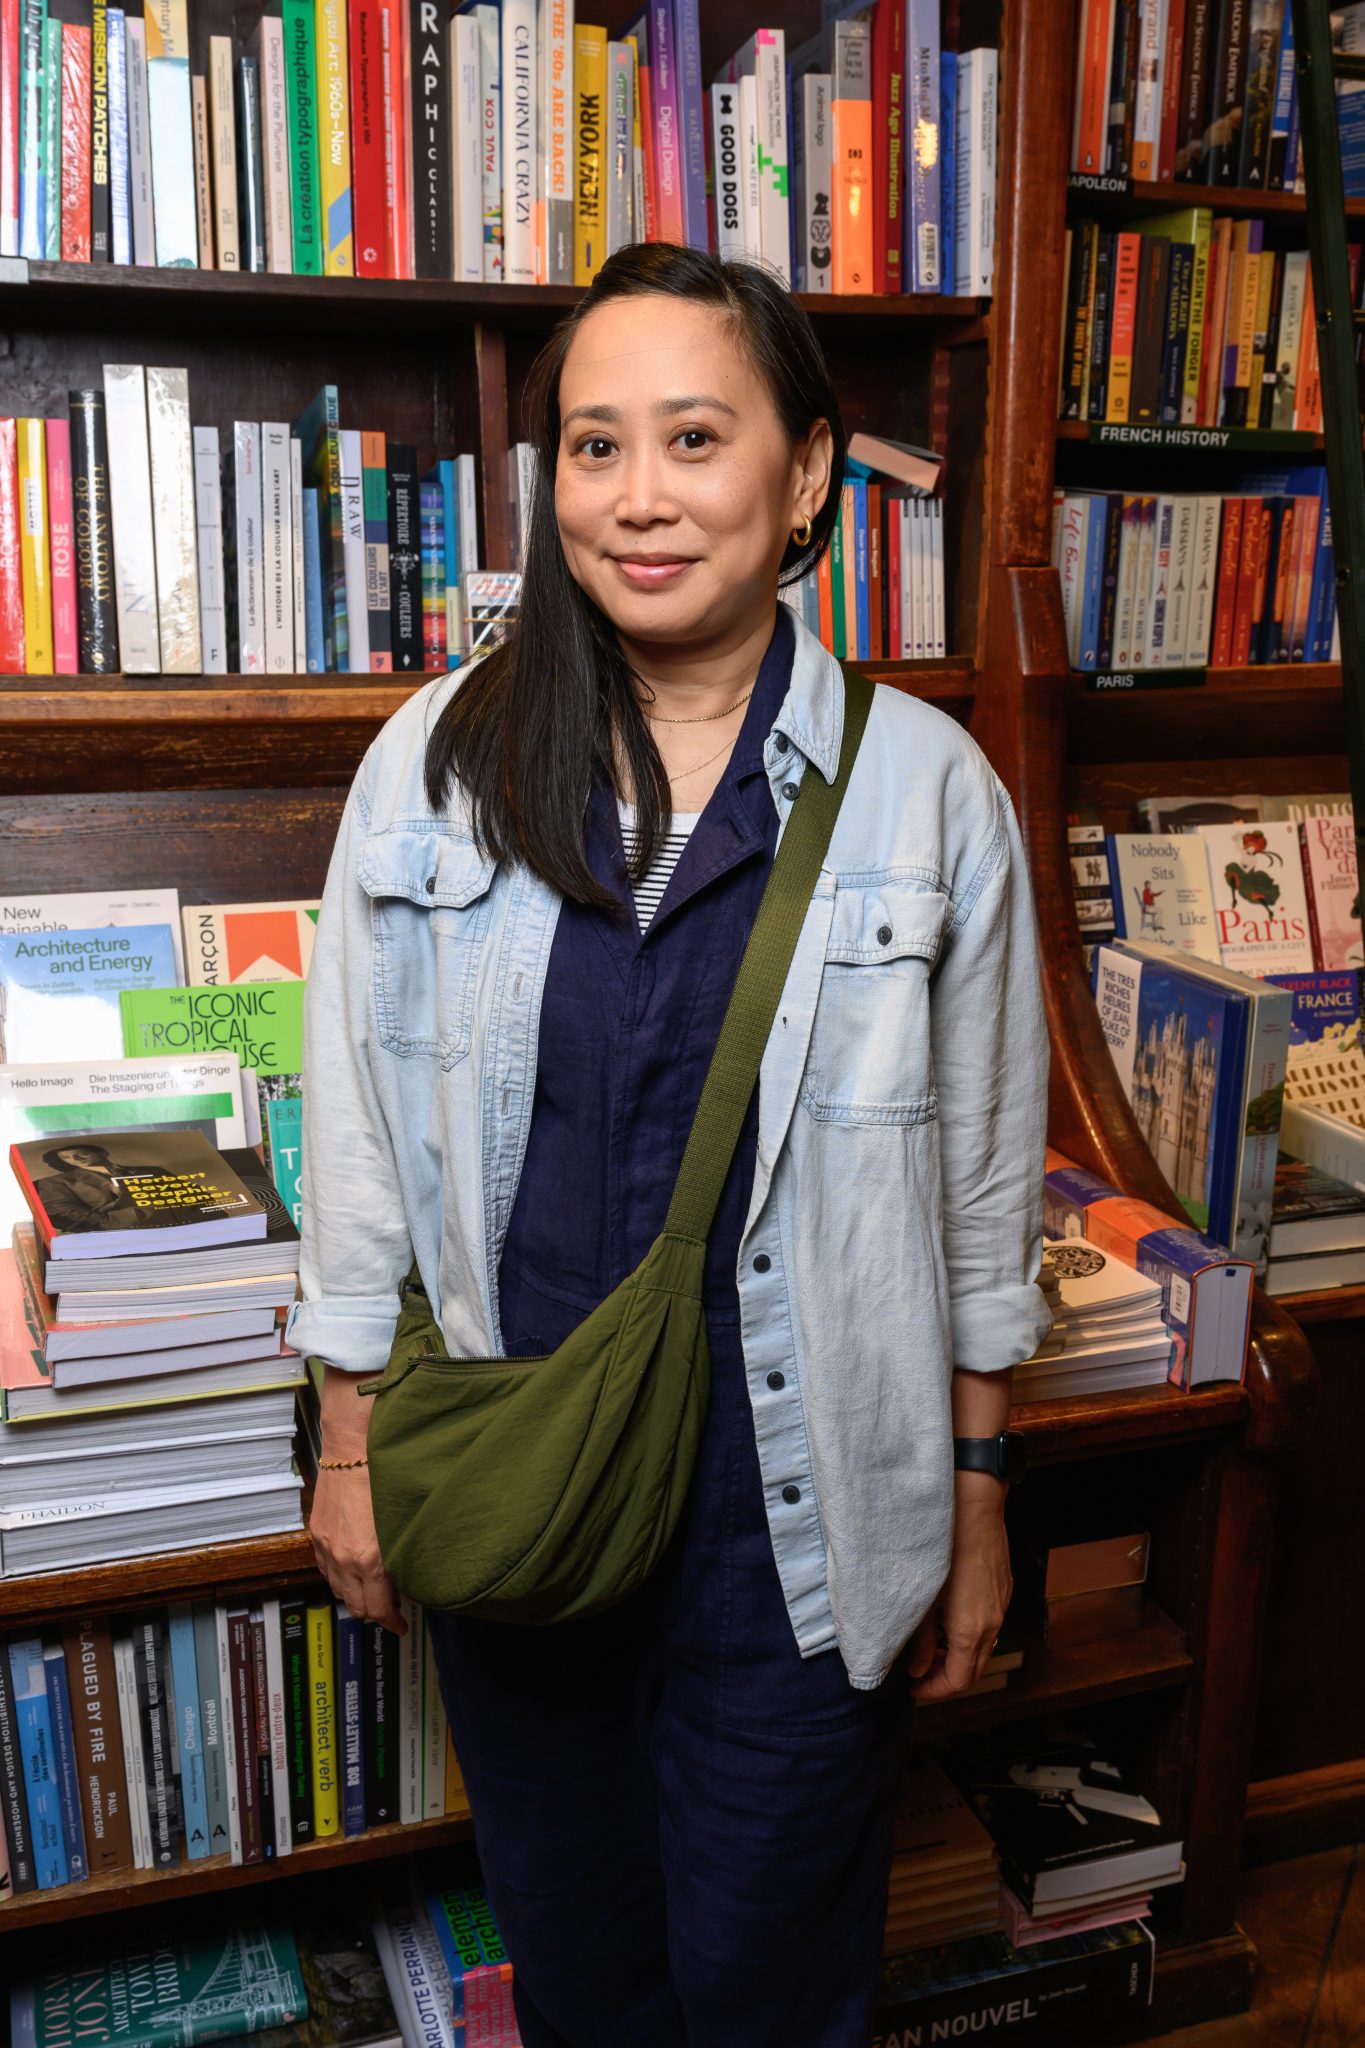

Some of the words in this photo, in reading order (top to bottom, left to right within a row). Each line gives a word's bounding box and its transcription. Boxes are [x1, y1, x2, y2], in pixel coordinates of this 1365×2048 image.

[552, 2, 564, 39] THE
[657, 8, 666, 45] Stephen
[93, 9, 107, 91] MISSION
[270, 37, 281, 80] Designs
[1191, 26, 1205, 72] SHADOW
[292, 18, 312, 146] typographique
[360, 58, 370, 113] Typography
[514, 25, 530, 151] CALIFORNIA
[889, 73, 901, 103] Jazz
[1225, 47, 1240, 104] EMPEROR
[272, 84, 281, 99] for
[552, 86, 564, 127] ARE
[816, 85, 826, 122] Animal
[1189, 74, 1201, 121] EMPEROR
[273, 101, 282, 119] the
[484, 98, 494, 129] COX
[579, 92, 600, 157] YORK
[889, 107, 901, 134] Age
[93, 93, 107, 185] PATCHES
[659, 106, 673, 147] Digital
[814, 123, 826, 146] logo
[273, 120, 285, 172] Pluriverse
[485, 136, 495, 172] PAUL
[720, 125, 736, 175] GOOD
[552, 133, 565, 193] BACK!
[661, 150, 674, 195] Design
[888, 138, 901, 219] Illustration
[298, 149, 313, 220] création
[515, 158, 530, 229] CRAZY
[579, 160, 600, 217] NEW
[722, 182, 738, 230] DOGS
[300, 224, 313, 244] La
[1192, 258, 1206, 325] ABSINTHE
[1285, 331, 1294, 350] SET
[1188, 331, 1201, 382] FORGER
[327, 396, 337, 428] CRUE
[1100, 426, 1162, 444] FRENCH
[1165, 428, 1230, 446] HISTORY
[329, 431, 339, 488] COULEUR
[75, 477, 89, 498] OF
[92, 464, 105, 501] THE
[341, 476, 361, 539] DRAW
[396, 488, 411, 545] RÉPERTOIRE
[429, 516, 437, 546] secrets
[1063, 507, 1083, 540] Left
[53, 522, 70, 578] ROSE
[77, 508, 93, 590] COLOUR
[95, 509, 110, 603] ANATOMY
[246, 557, 254, 567] de
[275, 559, 282, 570] LA
[1158, 551, 1170, 568] CITY
[275, 572, 282, 583] DE
[368, 546, 378, 590] COULEURS
[1063, 546, 1079, 584] Bank
[247, 569, 255, 615] dictionnaire
[379, 571, 388, 594] L'ART
[369, 592, 378, 608] LES
[380, 596, 388, 607] DE
[399, 591, 412, 639] COULEURS
[248, 617, 255, 627] Le
[429, 616, 440, 655] Couleurs
[1096, 675, 1134, 688] PARIS
[1130, 842, 1180, 860] Nobody
[1151, 865, 1175, 880] Sits
[3, 907, 42, 920] New
[1178, 911, 1207, 926] Like
[1216, 906, 1306, 945] Paris
[15, 938, 131, 959] Architecture
[50, 956, 83, 975] and
[89, 954, 154, 973] Energy
[1102, 966, 1117, 982] THE
[1105, 980, 1131, 1000] RICHES
[1319, 977, 1352, 990] BLACK
[170, 995, 185, 1005] THE
[189, 990, 277, 1019] ICONIC
[1102, 1004, 1111, 1016] OF
[1103, 992, 1131, 1014] HEURES
[1297, 991, 1353, 1009] FRANCE
[139, 1018, 253, 1048] TROPICAL
[1119, 1026, 1131, 1039] OF
[11, 1078, 38, 1088] Hello
[40, 1077, 74, 1088] Image
[89, 1074, 106, 1084] Die
[200, 1066, 230, 1076] Dinge
[90, 1084, 110, 1094] The
[113, 1082, 154, 1094] Staging
[157, 1080, 166, 1090] of
[123, 1172, 206, 1185] Herbert
[127, 1181, 197, 1192] Bayer,
[131, 1185, 218, 1199] Graphic
[135, 1190, 232, 1207] Designer
[20, 1501, 105, 1521] PHAIDON
[374, 1627, 383, 1653] Design
[79, 1620, 98, 1696] PLAGUED
[292, 1654, 300, 1674] What
[376, 1667, 384, 1679] the
[294, 1684, 302, 1709] Means
[376, 1681, 384, 1698] Real
[86, 1701, 101, 1721] BY
[207, 1699, 218, 1746] Montréal
[272, 1692, 283, 1741] l'entre-deux
[315, 1681, 330, 1755] architect,
[377, 1700, 385, 1722] World
[184, 1706, 196, 1750] Chicago
[91, 1727, 105, 1763] FIRE
[274, 1741, 285, 1771] habiter
[295, 1740, 305, 1773] Designer
[4, 1745, 14, 1778] DESIGN
[319, 1757, 335, 1792] verb
[347, 1765, 359, 1787] ROB
[8, 1780, 17, 1799] AND
[296, 1775, 306, 1797] Today
[89, 1775, 104, 1839] HENDRICKSON
[107, 1792, 117, 1817] PAUL
[11, 1801, 24, 1853] MODERNISM
[1129, 1962, 1138, 1996] TASCHEN
[931, 1999, 1038, 2043] NOUVEL
